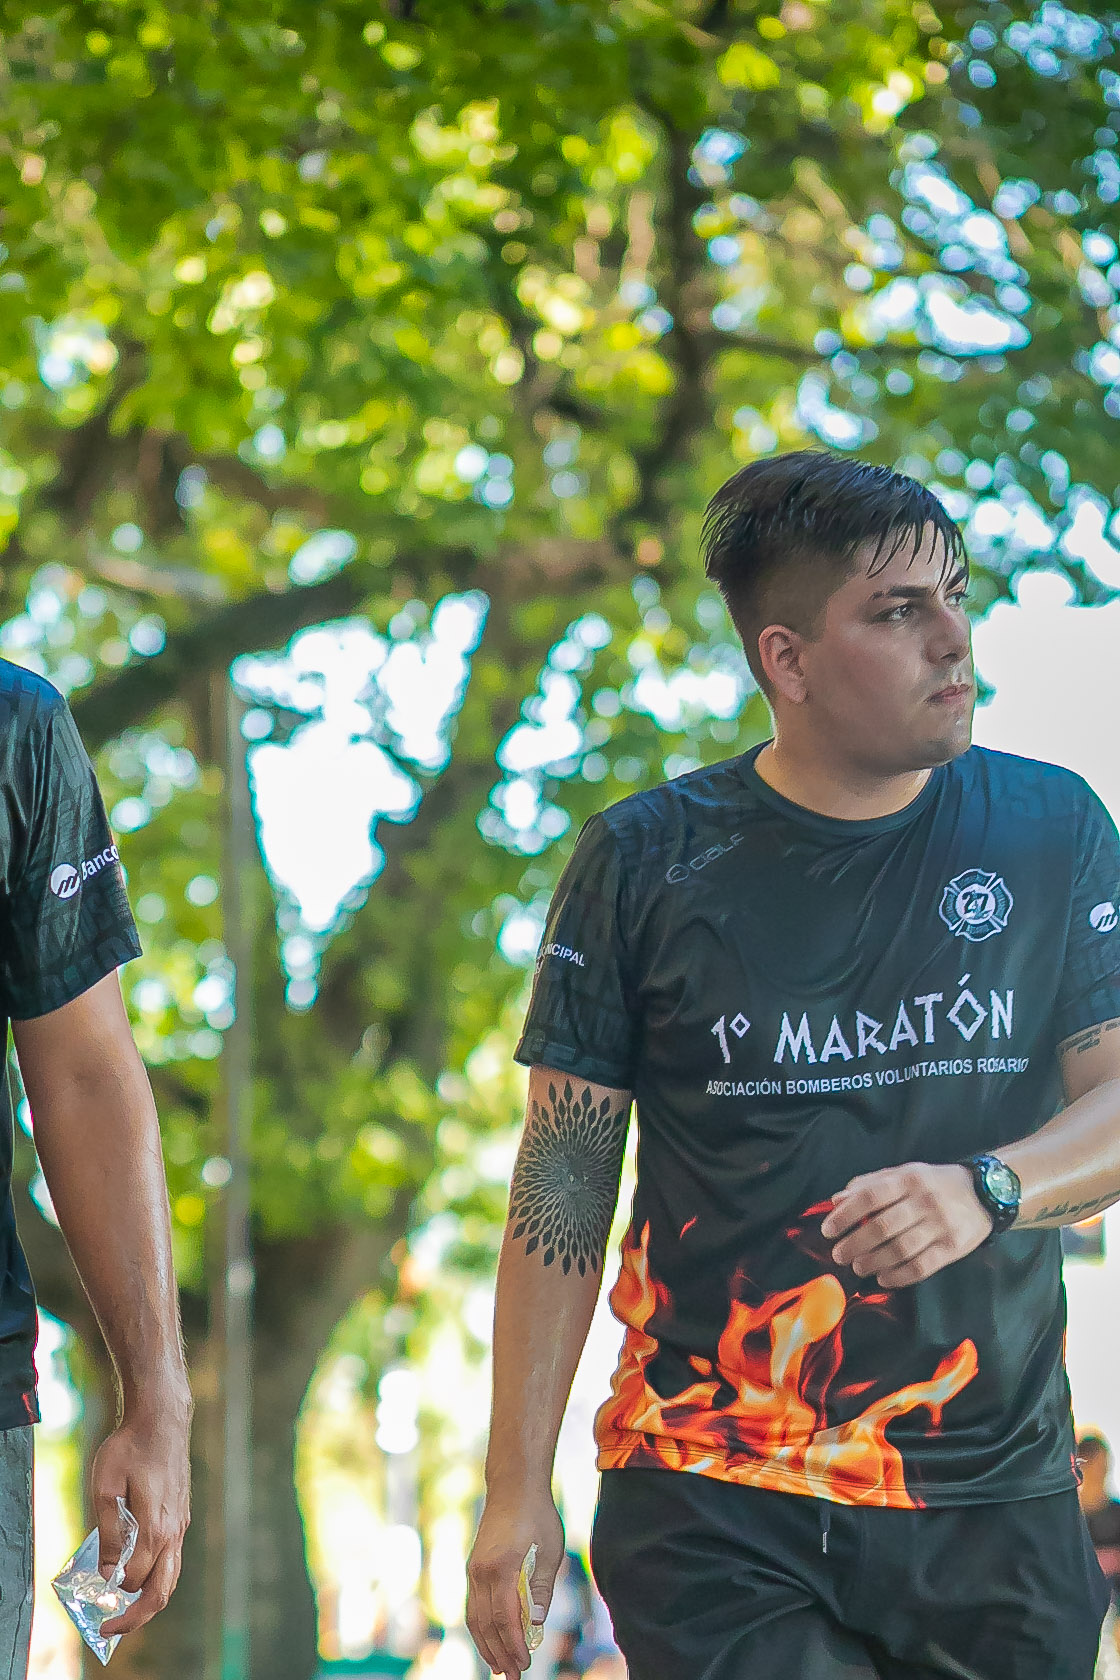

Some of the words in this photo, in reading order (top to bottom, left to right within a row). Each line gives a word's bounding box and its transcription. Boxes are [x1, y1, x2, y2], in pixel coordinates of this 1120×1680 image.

[773, 972, 1014, 1064] MARATÓN
[705, 1077, 782, 1096] ASOCIACIÓN
[786, 1072, 873, 1095] BOMBEROS
[875, 1058, 973, 1086] VOLUNTARIOS
